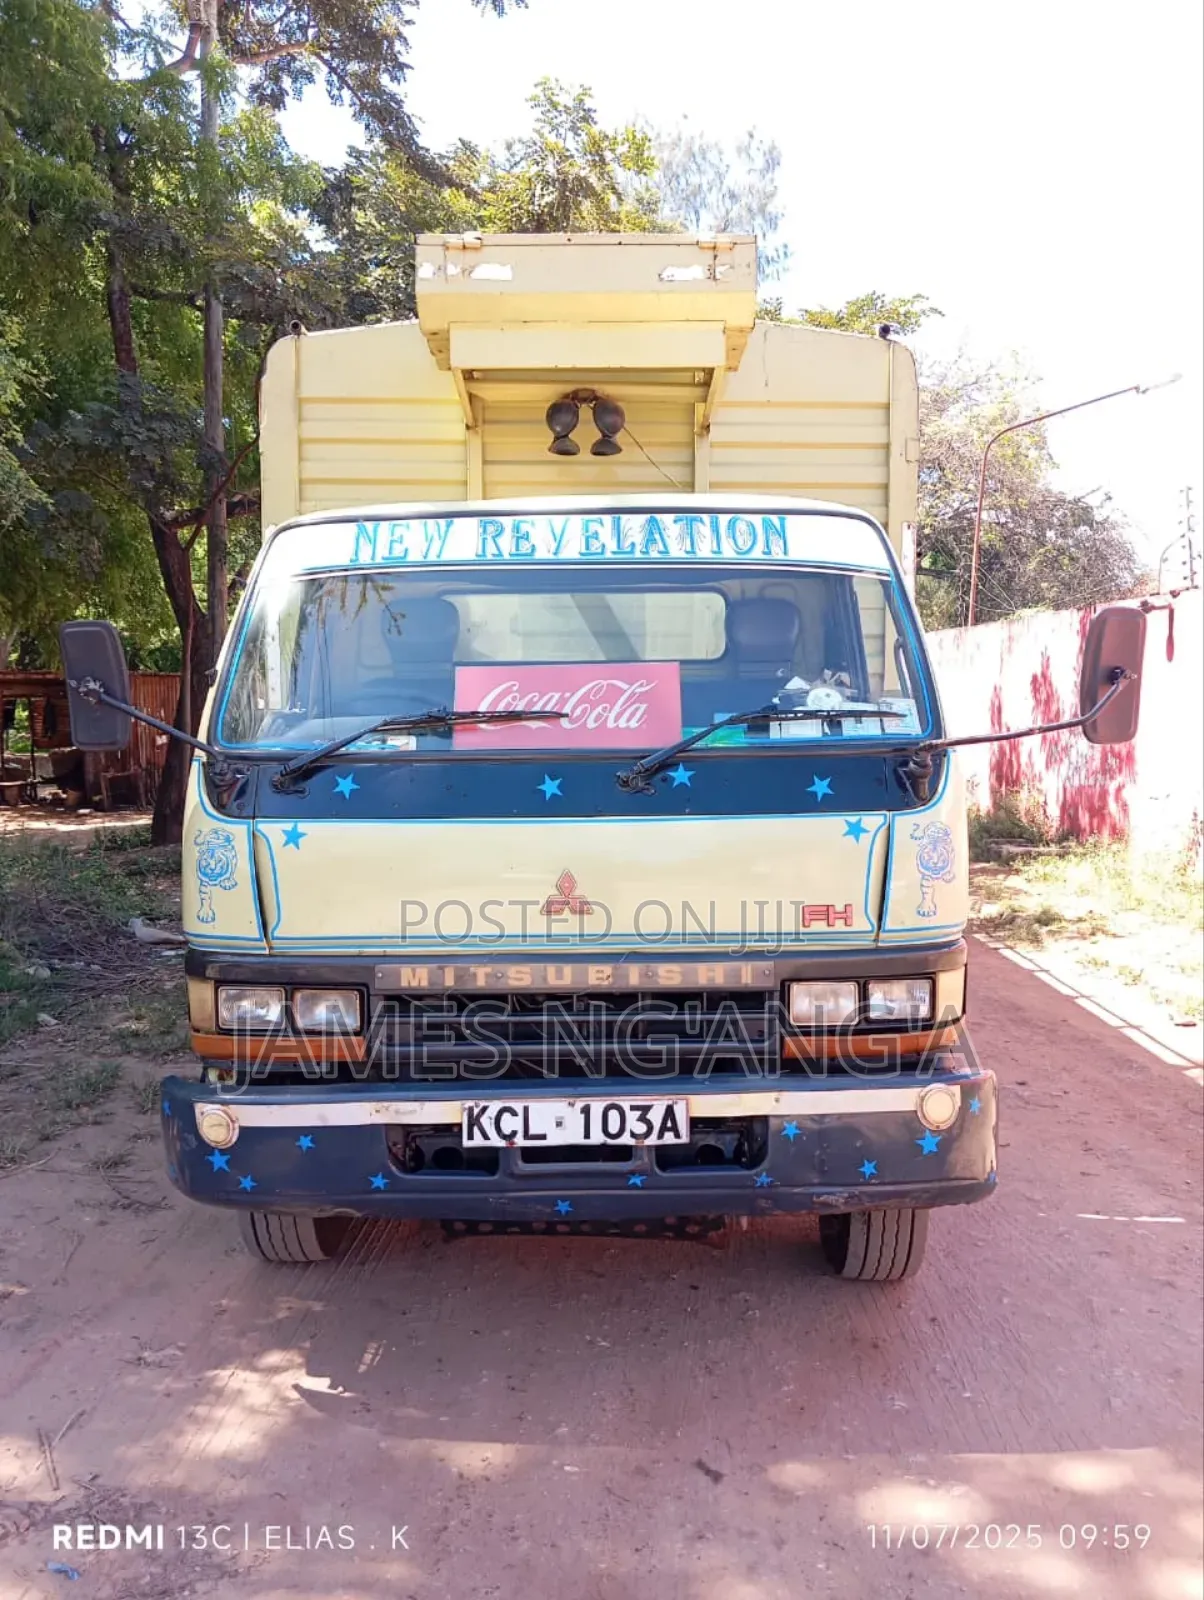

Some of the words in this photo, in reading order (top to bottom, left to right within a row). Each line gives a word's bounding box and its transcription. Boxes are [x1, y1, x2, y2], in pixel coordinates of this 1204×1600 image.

[350, 518, 454, 564] NEW
[474, 514, 789, 559] REVELATION
[802, 903, 853, 928] FH
[400, 963, 754, 987] MITSUBISHI
[466, 1104, 547, 1141] KCL
[580, 1102, 682, 1140] 103A
